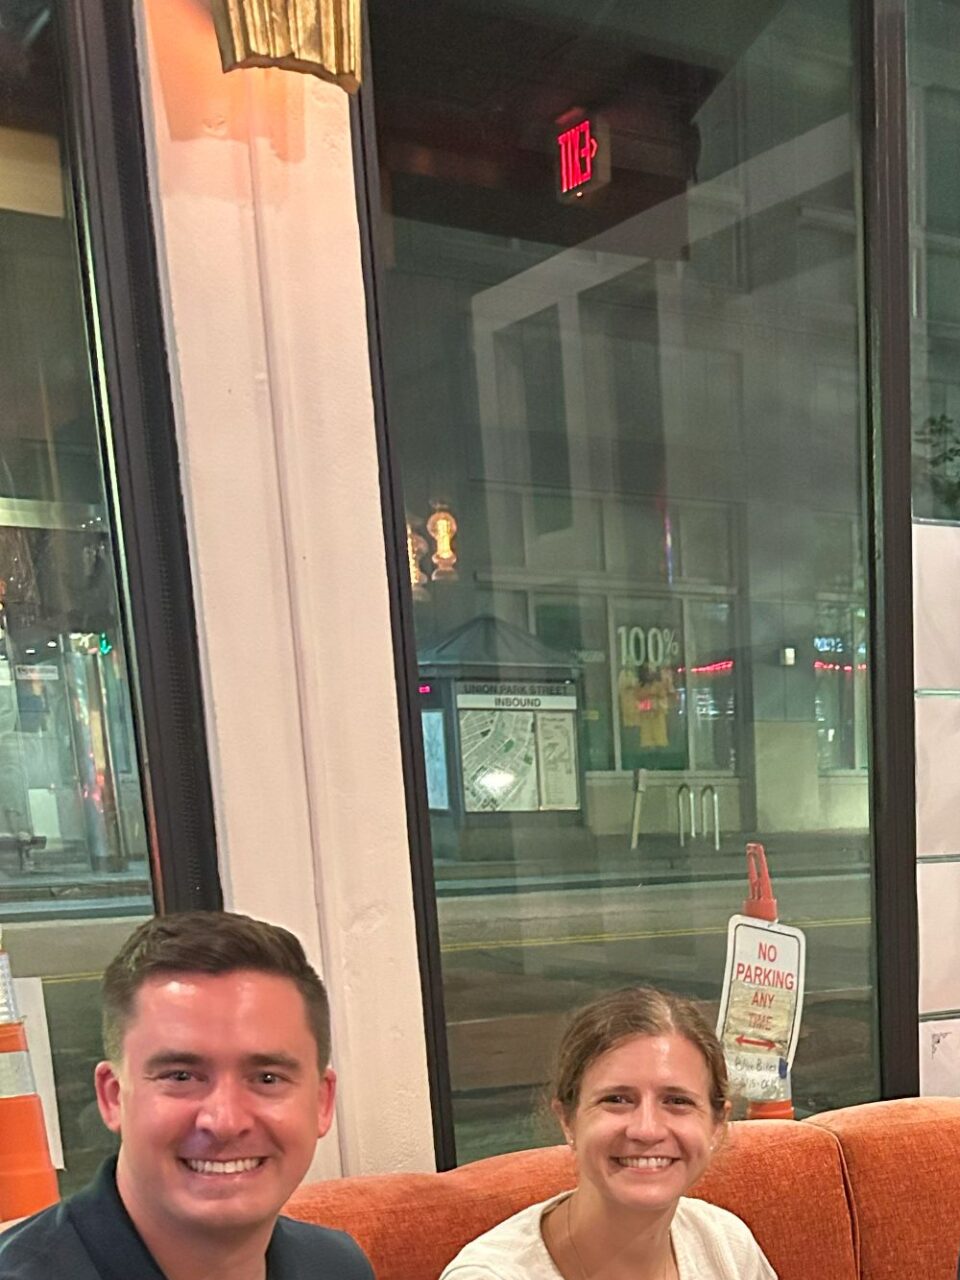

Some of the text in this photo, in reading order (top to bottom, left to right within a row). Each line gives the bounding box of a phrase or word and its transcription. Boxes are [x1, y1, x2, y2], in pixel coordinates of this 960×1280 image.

[617, 625, 679, 667] 100%
[463, 683, 567, 695] UNION PARK STREET
[494, 697, 541, 708] INBOUND
[758, 942, 777, 962] NO
[736, 962, 794, 990] PARKING
[751, 991, 775, 1009] ANY
[748, 1012, 773, 1031] TIME
